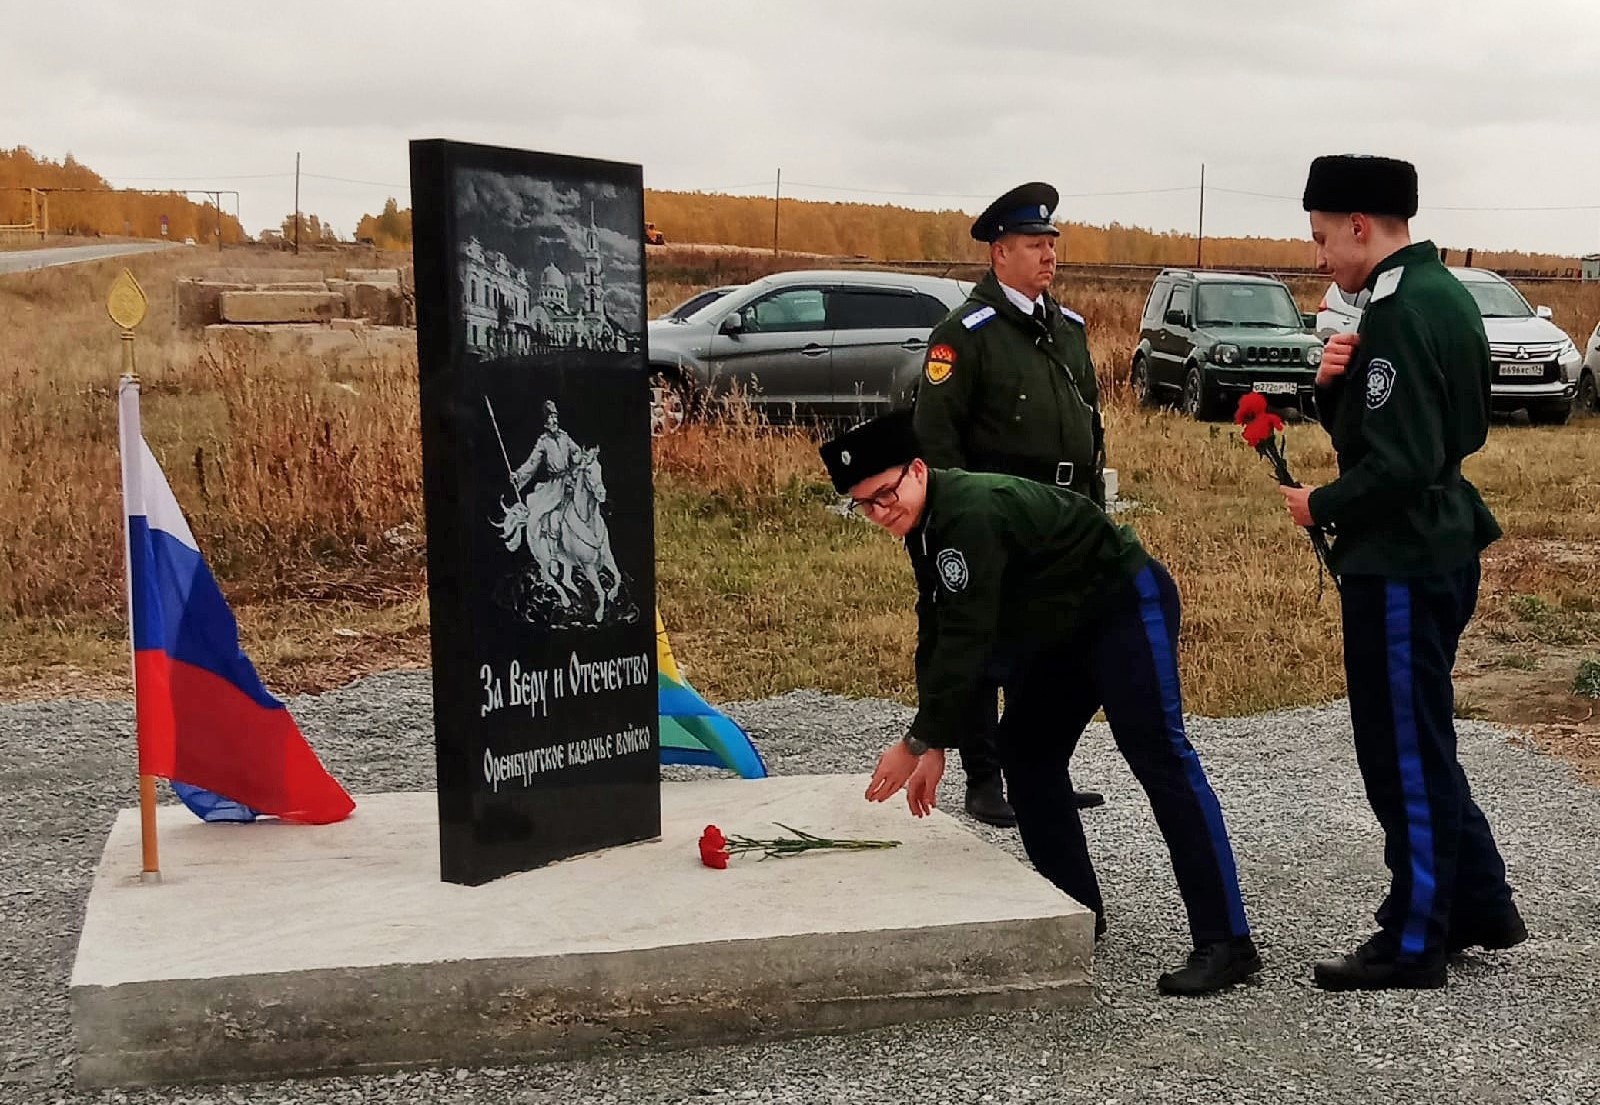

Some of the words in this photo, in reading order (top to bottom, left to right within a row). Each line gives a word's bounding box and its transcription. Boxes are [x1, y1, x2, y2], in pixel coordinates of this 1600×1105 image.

[480, 664, 504, 718] За
[510, 660, 548, 718] Веру
[553, 668, 564, 698] и
[484, 745, 564, 793] Оренбургское
[568, 735, 613, 765] казачье
[616, 722, 650, 756] войско
